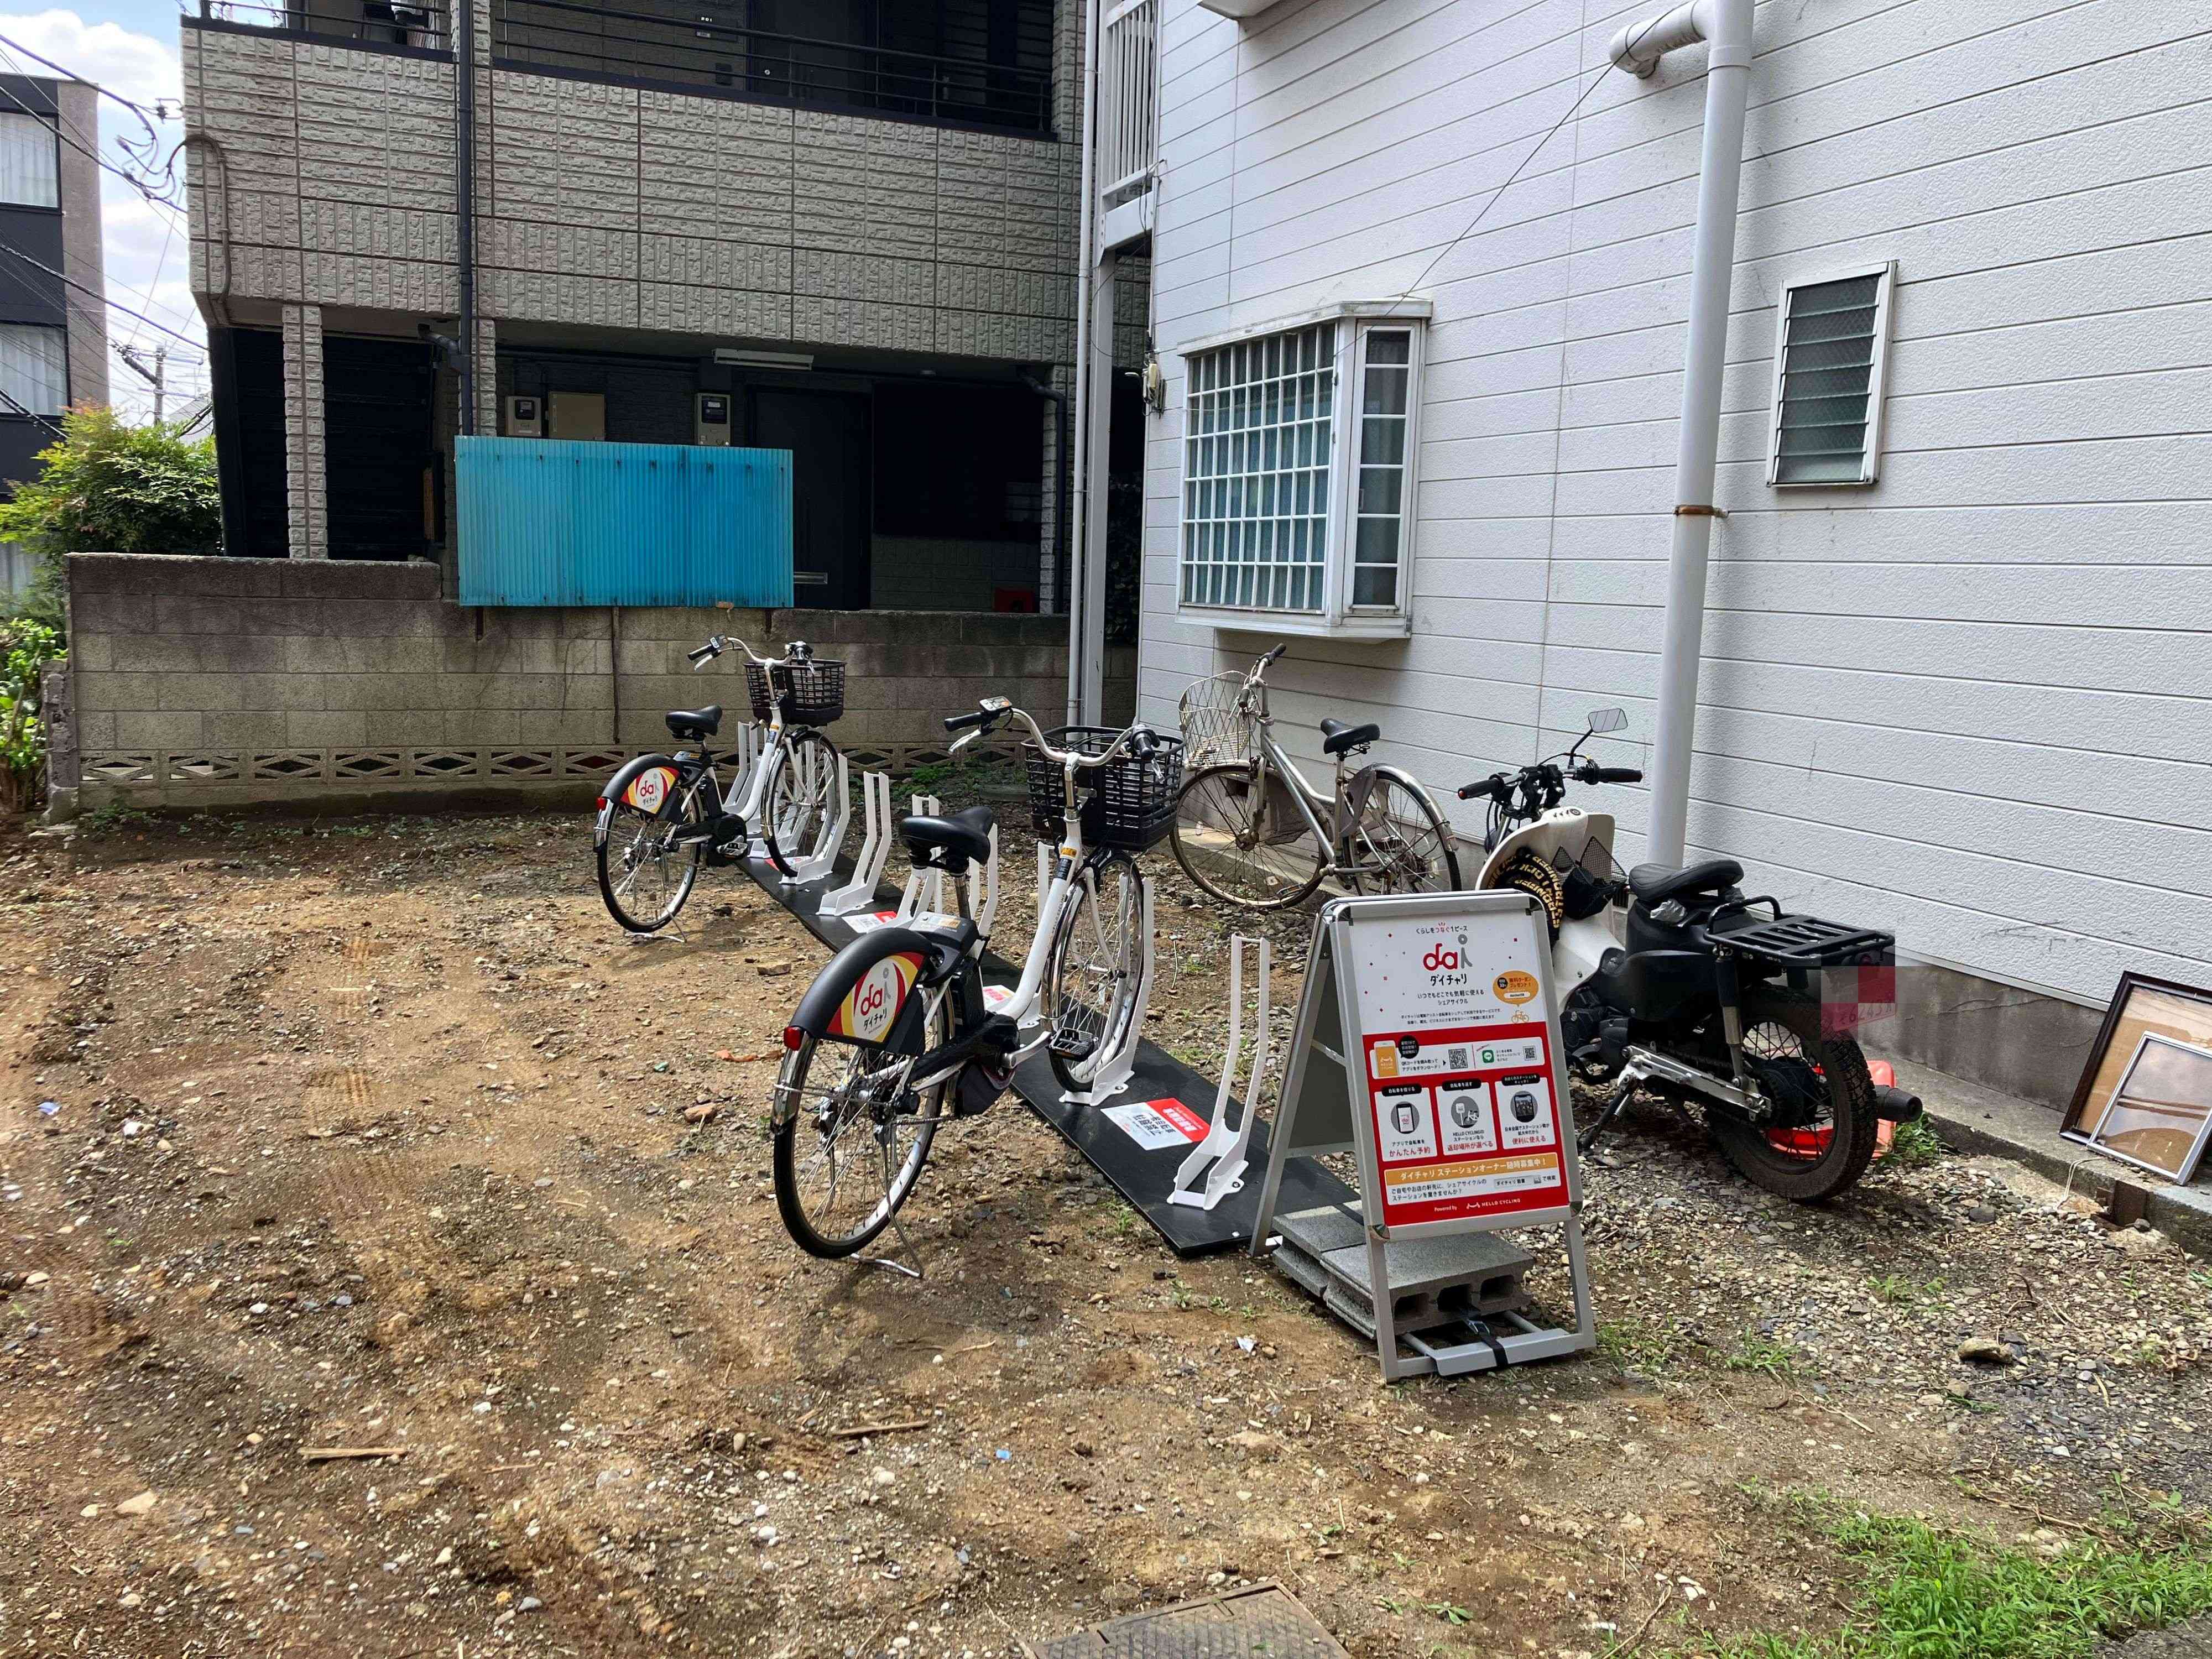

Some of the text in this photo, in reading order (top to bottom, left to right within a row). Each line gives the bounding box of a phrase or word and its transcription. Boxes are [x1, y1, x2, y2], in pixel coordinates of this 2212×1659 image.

[1423, 934, 1473, 971] dai
[1430, 974, 1468, 987] ダイチャリ
[860, 968, 891, 1015] dai
[1418, 989, 1484, 999] いつでもどこでも気軽に使える
[864, 1007, 887, 1031] ダイチャリ
[1512, 1135, 1546, 1145] 便利に使える
[1389, 1146, 1431, 1157] かんたん予約
[1448, 1141, 1493, 1151] 返却場所が選べる
[1400, 1170, 1435, 1181] ダイチャリ
